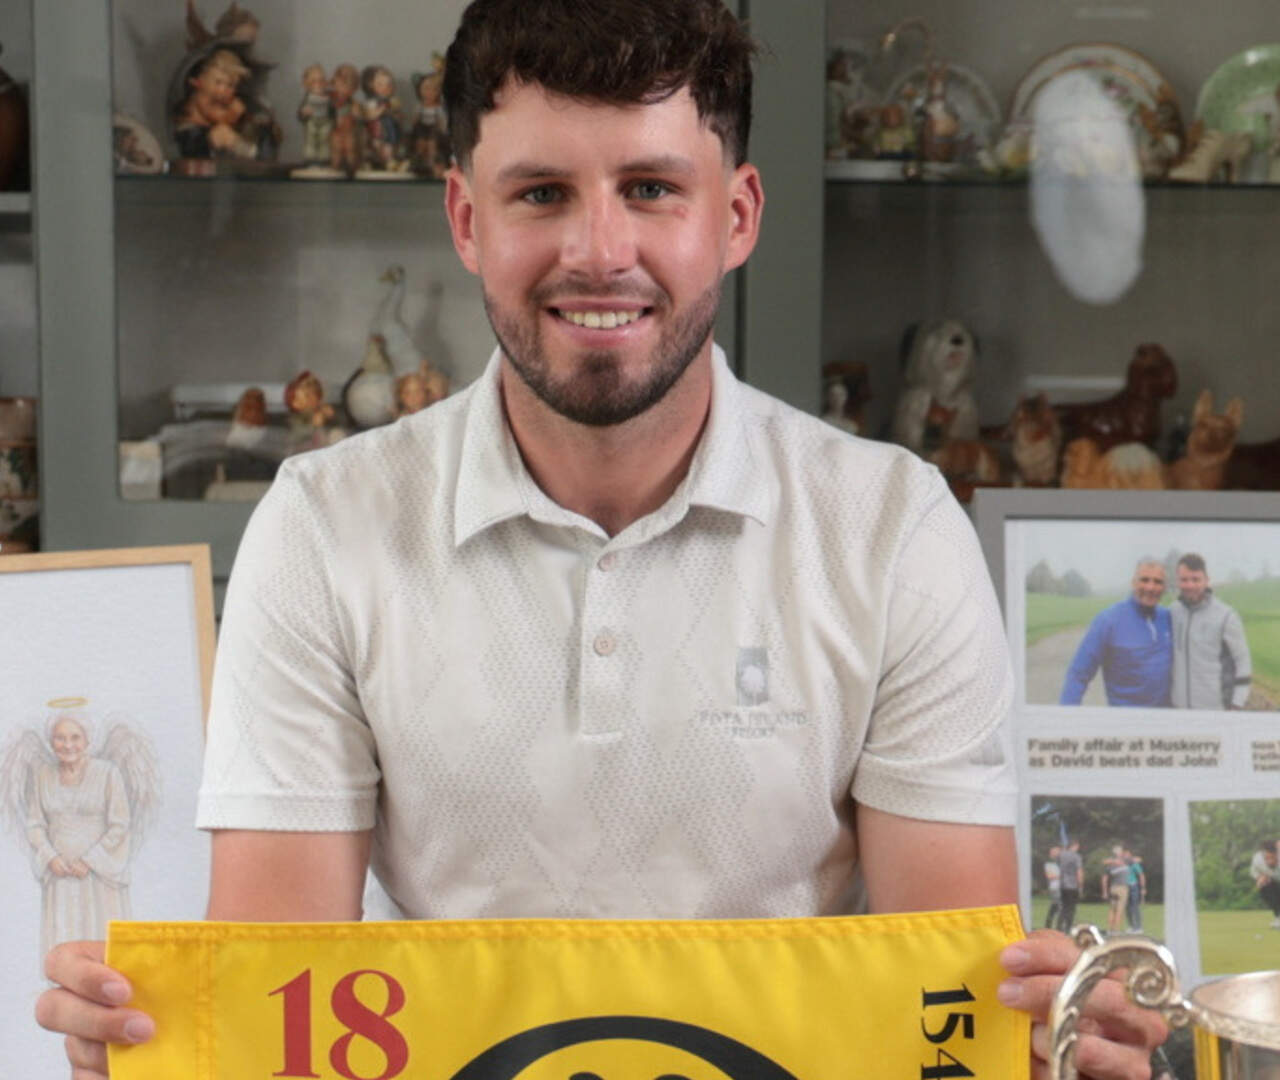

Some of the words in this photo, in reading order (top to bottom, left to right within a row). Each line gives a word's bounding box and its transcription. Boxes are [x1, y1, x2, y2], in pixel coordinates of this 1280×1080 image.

[1028, 738, 1078, 754] Family
[1084, 738, 1124, 752] affair
[1129, 738, 1144, 752] at
[1150, 738, 1220, 753] Muskerry
[1029, 756, 1045, 768] as
[1052, 755, 1094, 768] David
[1100, 755, 1141, 768] beats
[1146, 755, 1174, 768] dad
[1179, 755, 1218, 768] John
